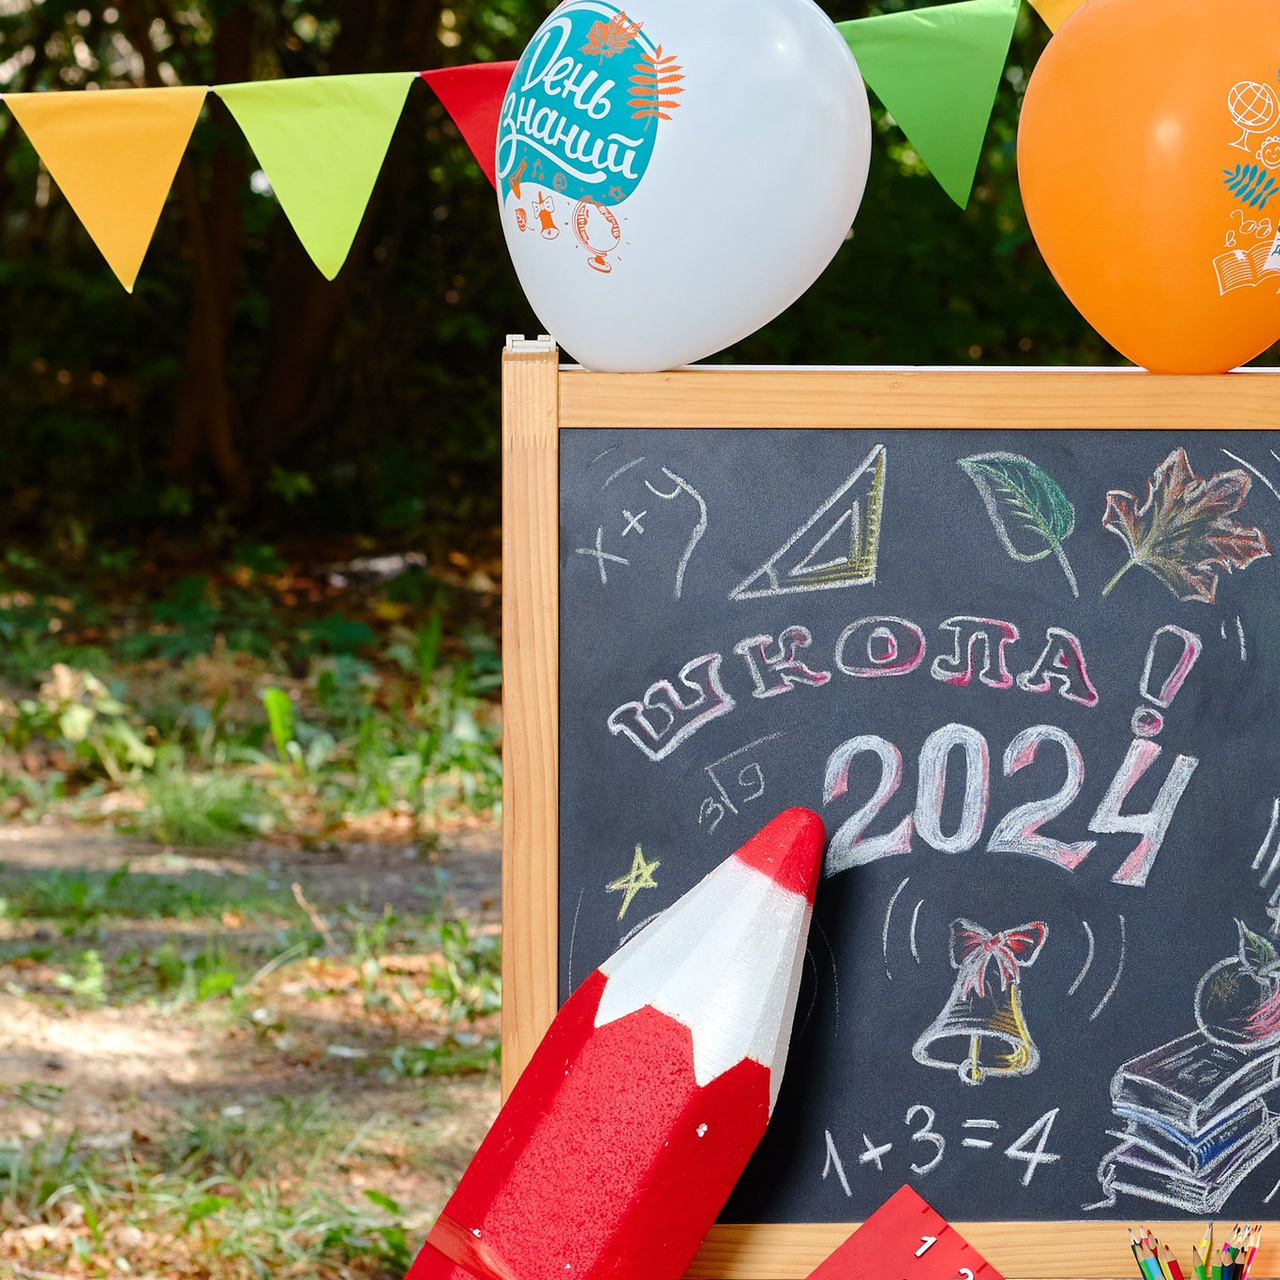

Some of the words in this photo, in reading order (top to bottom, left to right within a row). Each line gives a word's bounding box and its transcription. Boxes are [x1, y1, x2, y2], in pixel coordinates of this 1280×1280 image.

[521, 17, 616, 119] День
[822, 722, 1199, 887] 2024
[914, 1235, 937, 1260] 1
